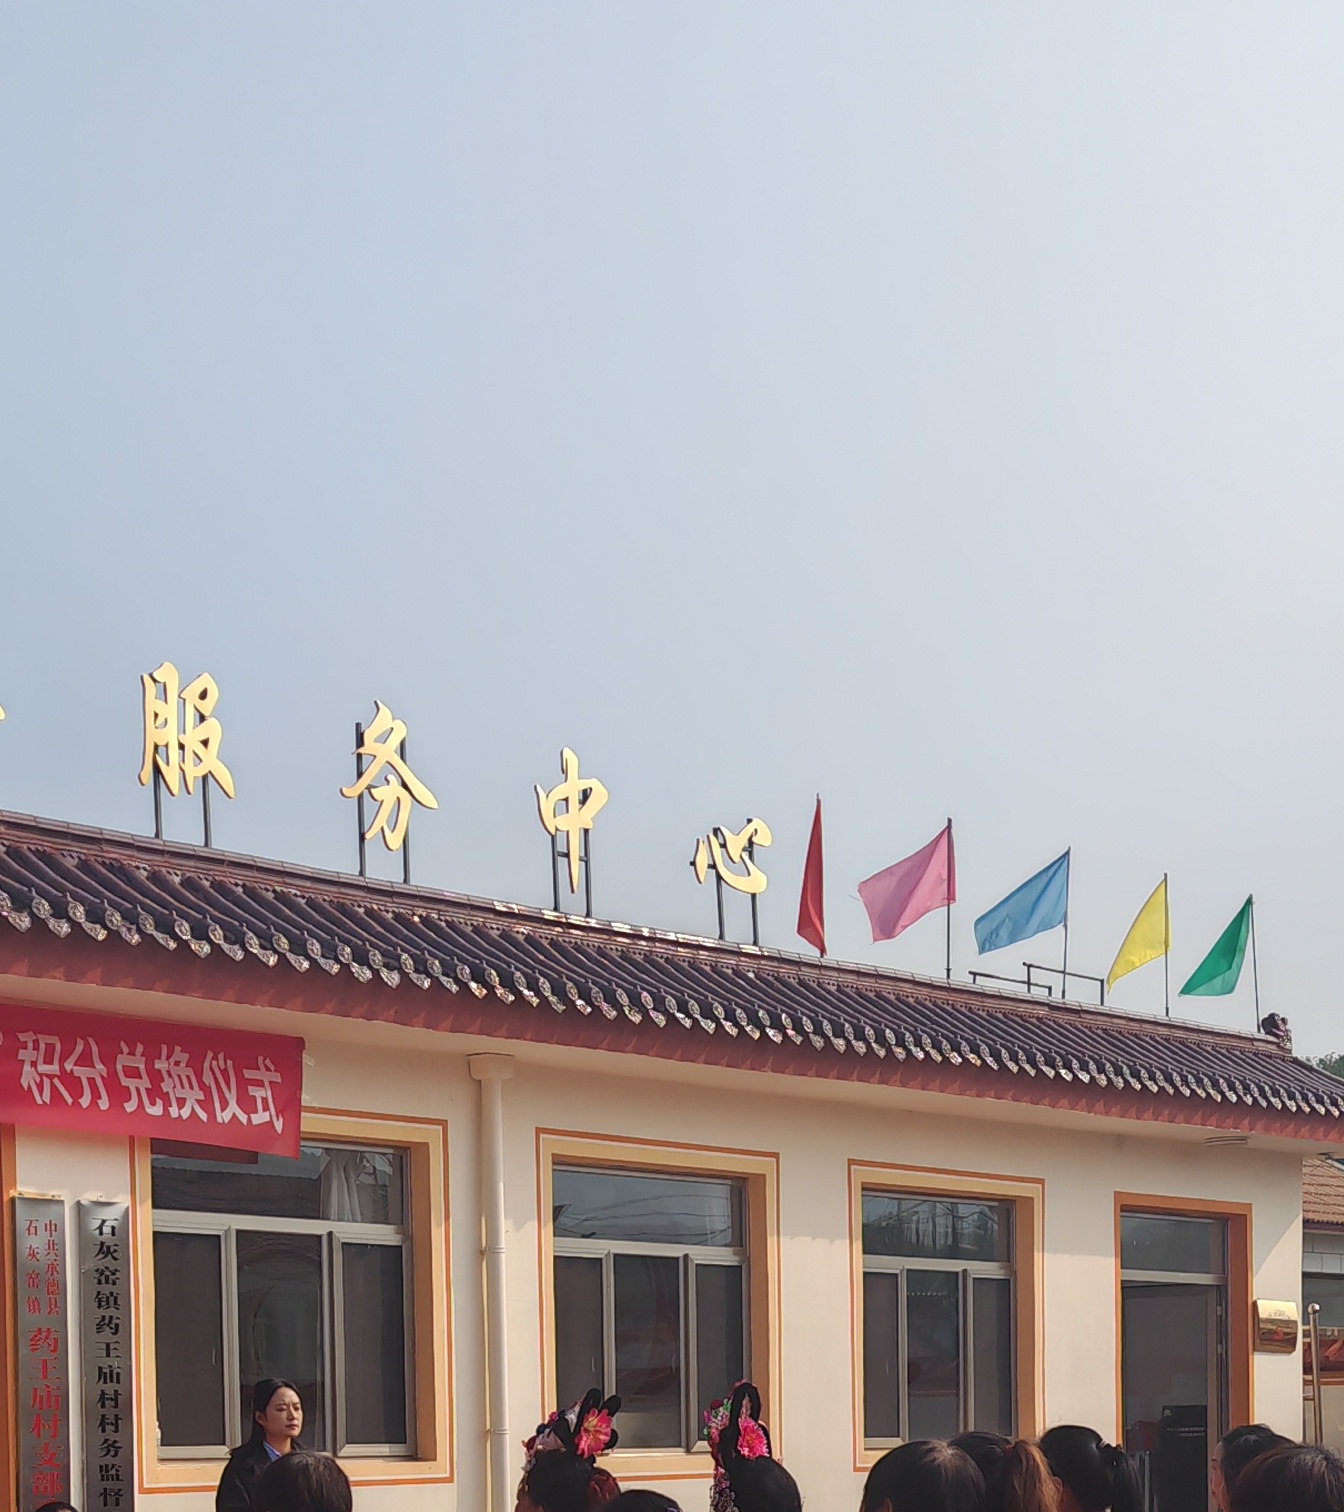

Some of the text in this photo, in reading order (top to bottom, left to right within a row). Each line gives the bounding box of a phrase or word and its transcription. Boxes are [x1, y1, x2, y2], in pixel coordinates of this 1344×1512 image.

[24, 1218, 42, 1315] 石灰窑镇
[43, 1218, 61, 1316] 中共承德县
[28, 1327, 64, 1508] 药王庙村支部
